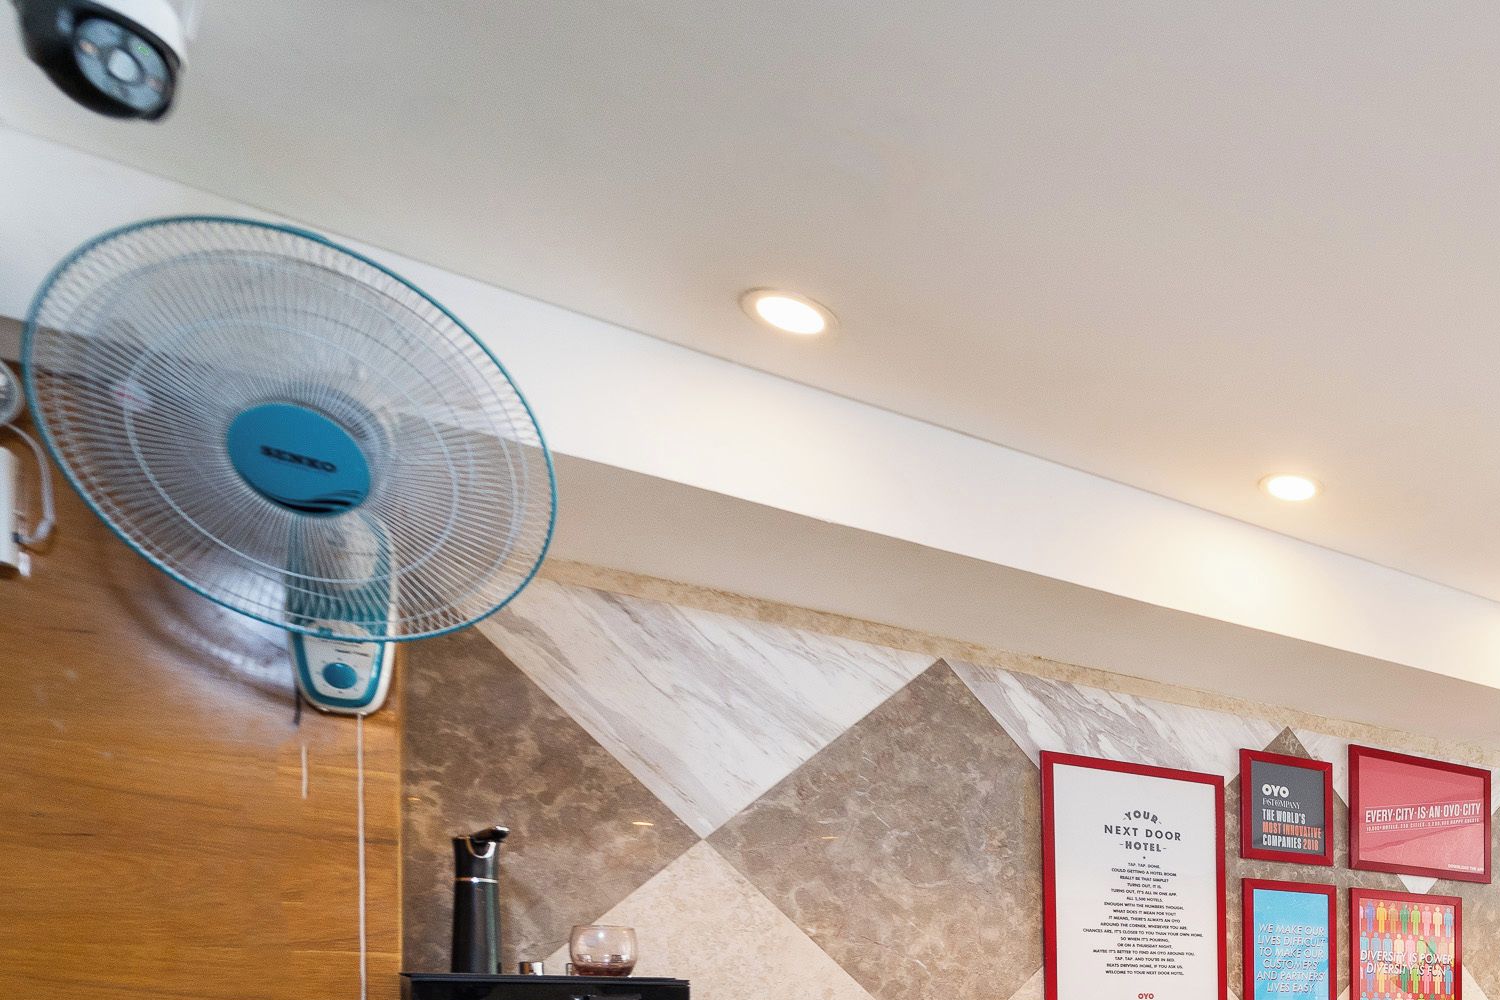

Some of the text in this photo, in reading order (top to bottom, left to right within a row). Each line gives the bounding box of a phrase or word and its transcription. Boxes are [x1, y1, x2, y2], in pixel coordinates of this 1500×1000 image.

[1262, 783, 1290, 798] OYO
[1125, 810, 1158, 824] YOUR
[1262, 809, 1306, 825] THE WORLD'S
[1365, 803, 1481, 823] EVERY CITY IS AN OYO CITY
[1104, 824, 1181, 841] NEXT DOOR
[1262, 821, 1322, 839] MOST INNOVATIVE
[1262, 833, 1302, 849] COMPANIES
[1258, 923, 1325, 937] WE MAKE OUR
[1257, 935, 1326, 948] LIVES DIFFICULT
[1259, 946, 1324, 959] TO MAKE OUR
[1360, 949, 1454, 965] DIVERSITY IS POWER
[1256, 970, 1278, 981] AND
[1366, 962, 1446, 977] DIVERSITY IS FUN
[1267, 982, 1290, 993] LIVES
